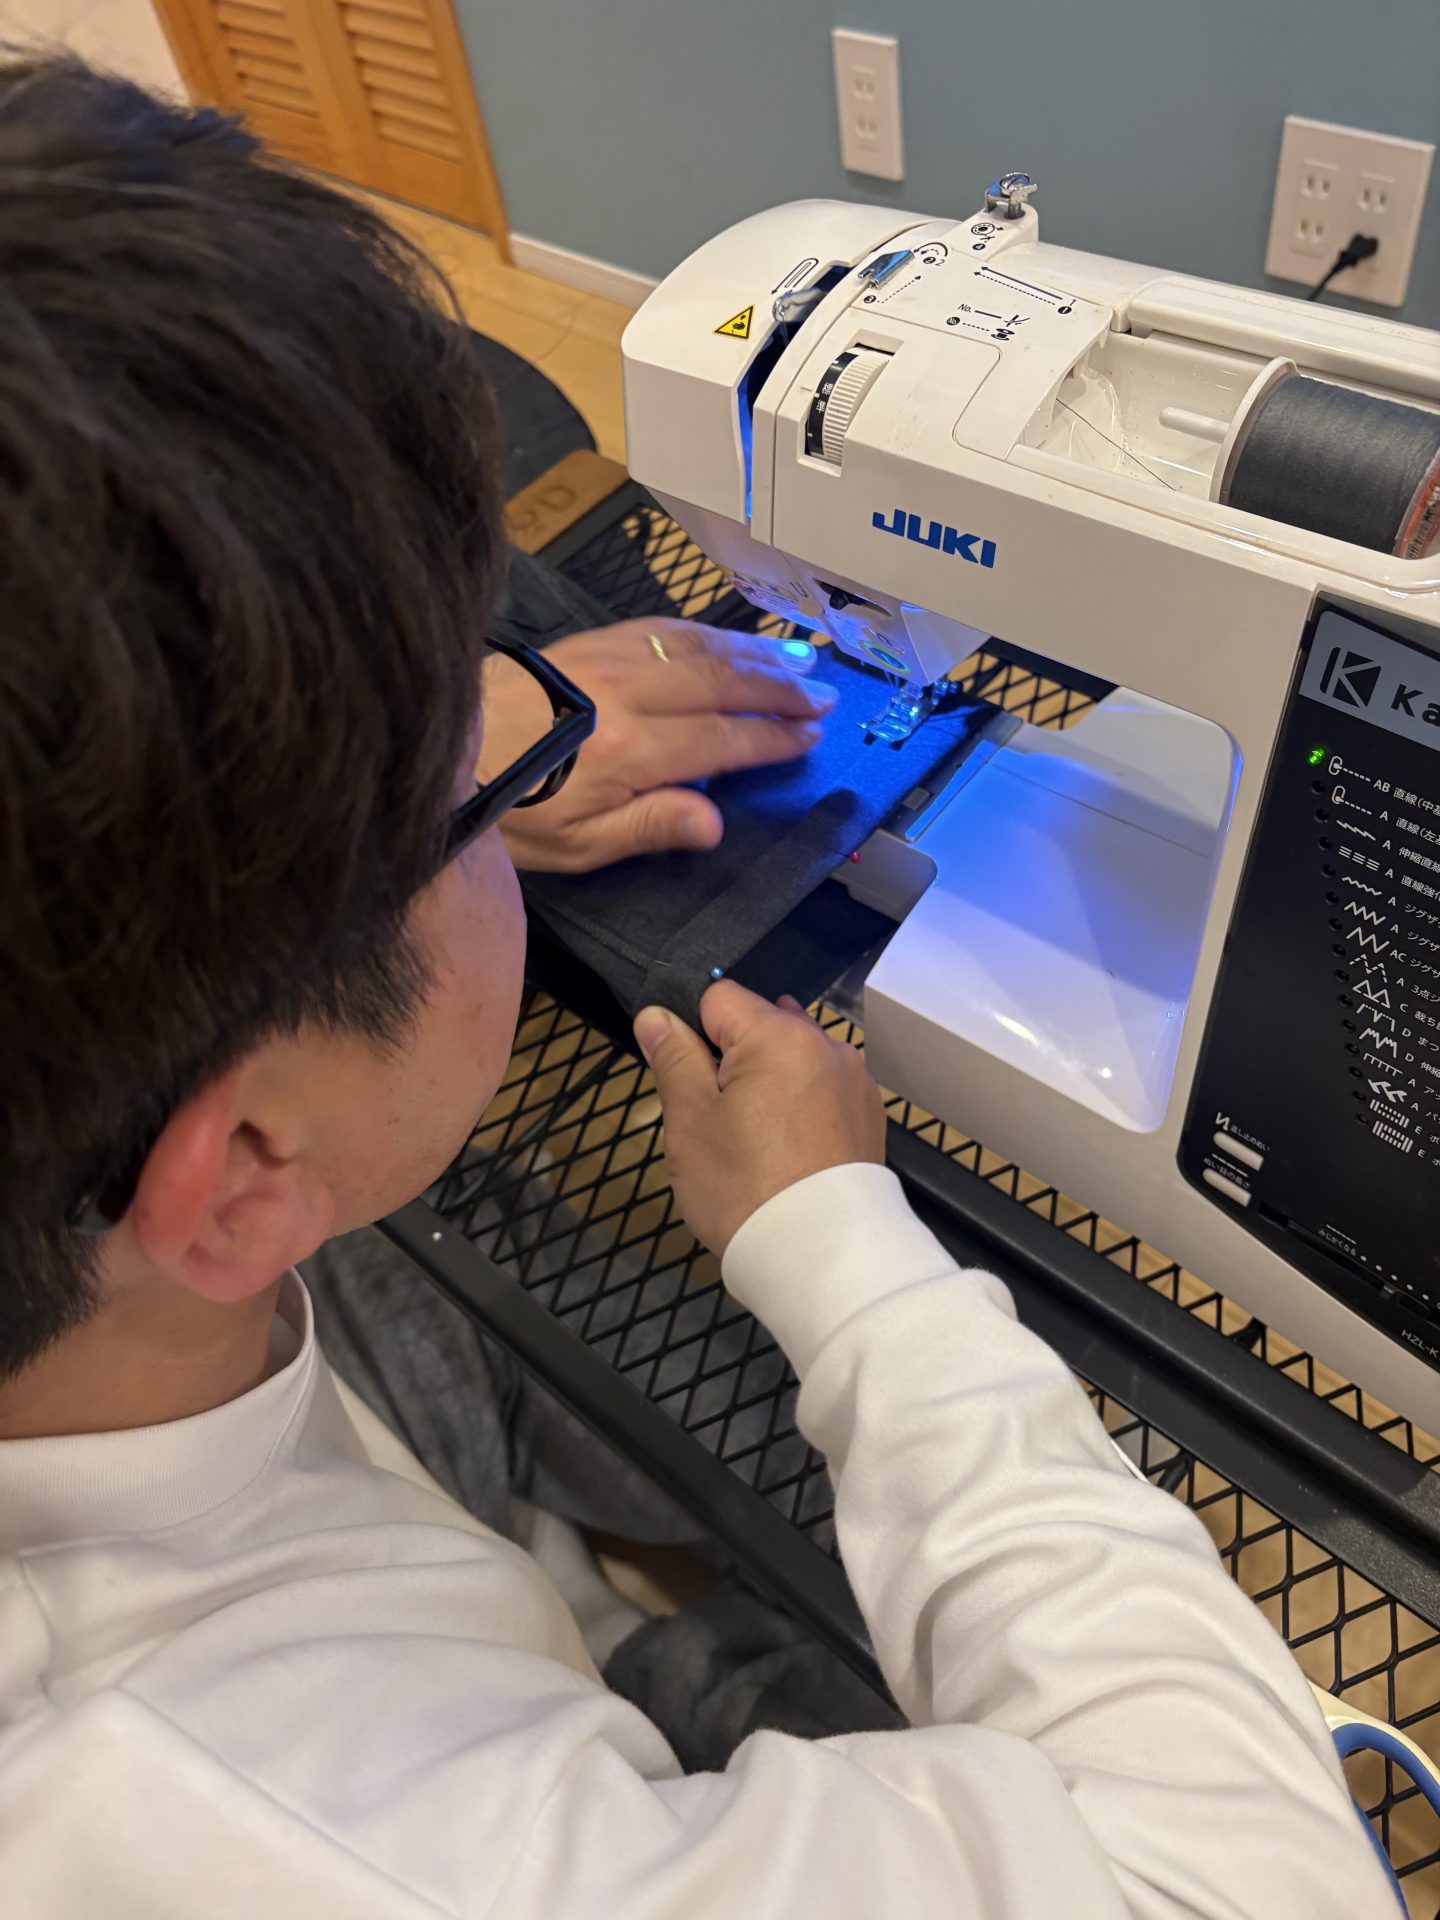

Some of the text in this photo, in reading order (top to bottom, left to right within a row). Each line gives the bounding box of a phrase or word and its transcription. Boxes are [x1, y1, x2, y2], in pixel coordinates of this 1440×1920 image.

[935, 259, 945, 267] 2
[957, 303, 972, 313] No.
[872, 508, 997, 569] JUKI
[1373, 779, 1391, 793] AB
[1379, 810, 1388, 821] A
[1382, 839, 1391, 850] A
[1384, 868, 1394, 879] A
[1387, 896, 1396, 907] A
[1390, 923, 1399, 934] A
[1389, 949, 1407, 962] AC
[1396, 977, 1404, 987] A
[1399, 1003, 1409, 1013] C
[1402, 1027, 1412, 1037] D
[1405, 1052, 1415, 1062] D
[1407, 1078, 1416, 1088] A
[1410, 1102, 1419, 1112] A
[1414, 1125, 1423, 1135] E
[1417, 1149, 1425, 1158] E
[1401, 1329, 1440, 1360] HZL-K
